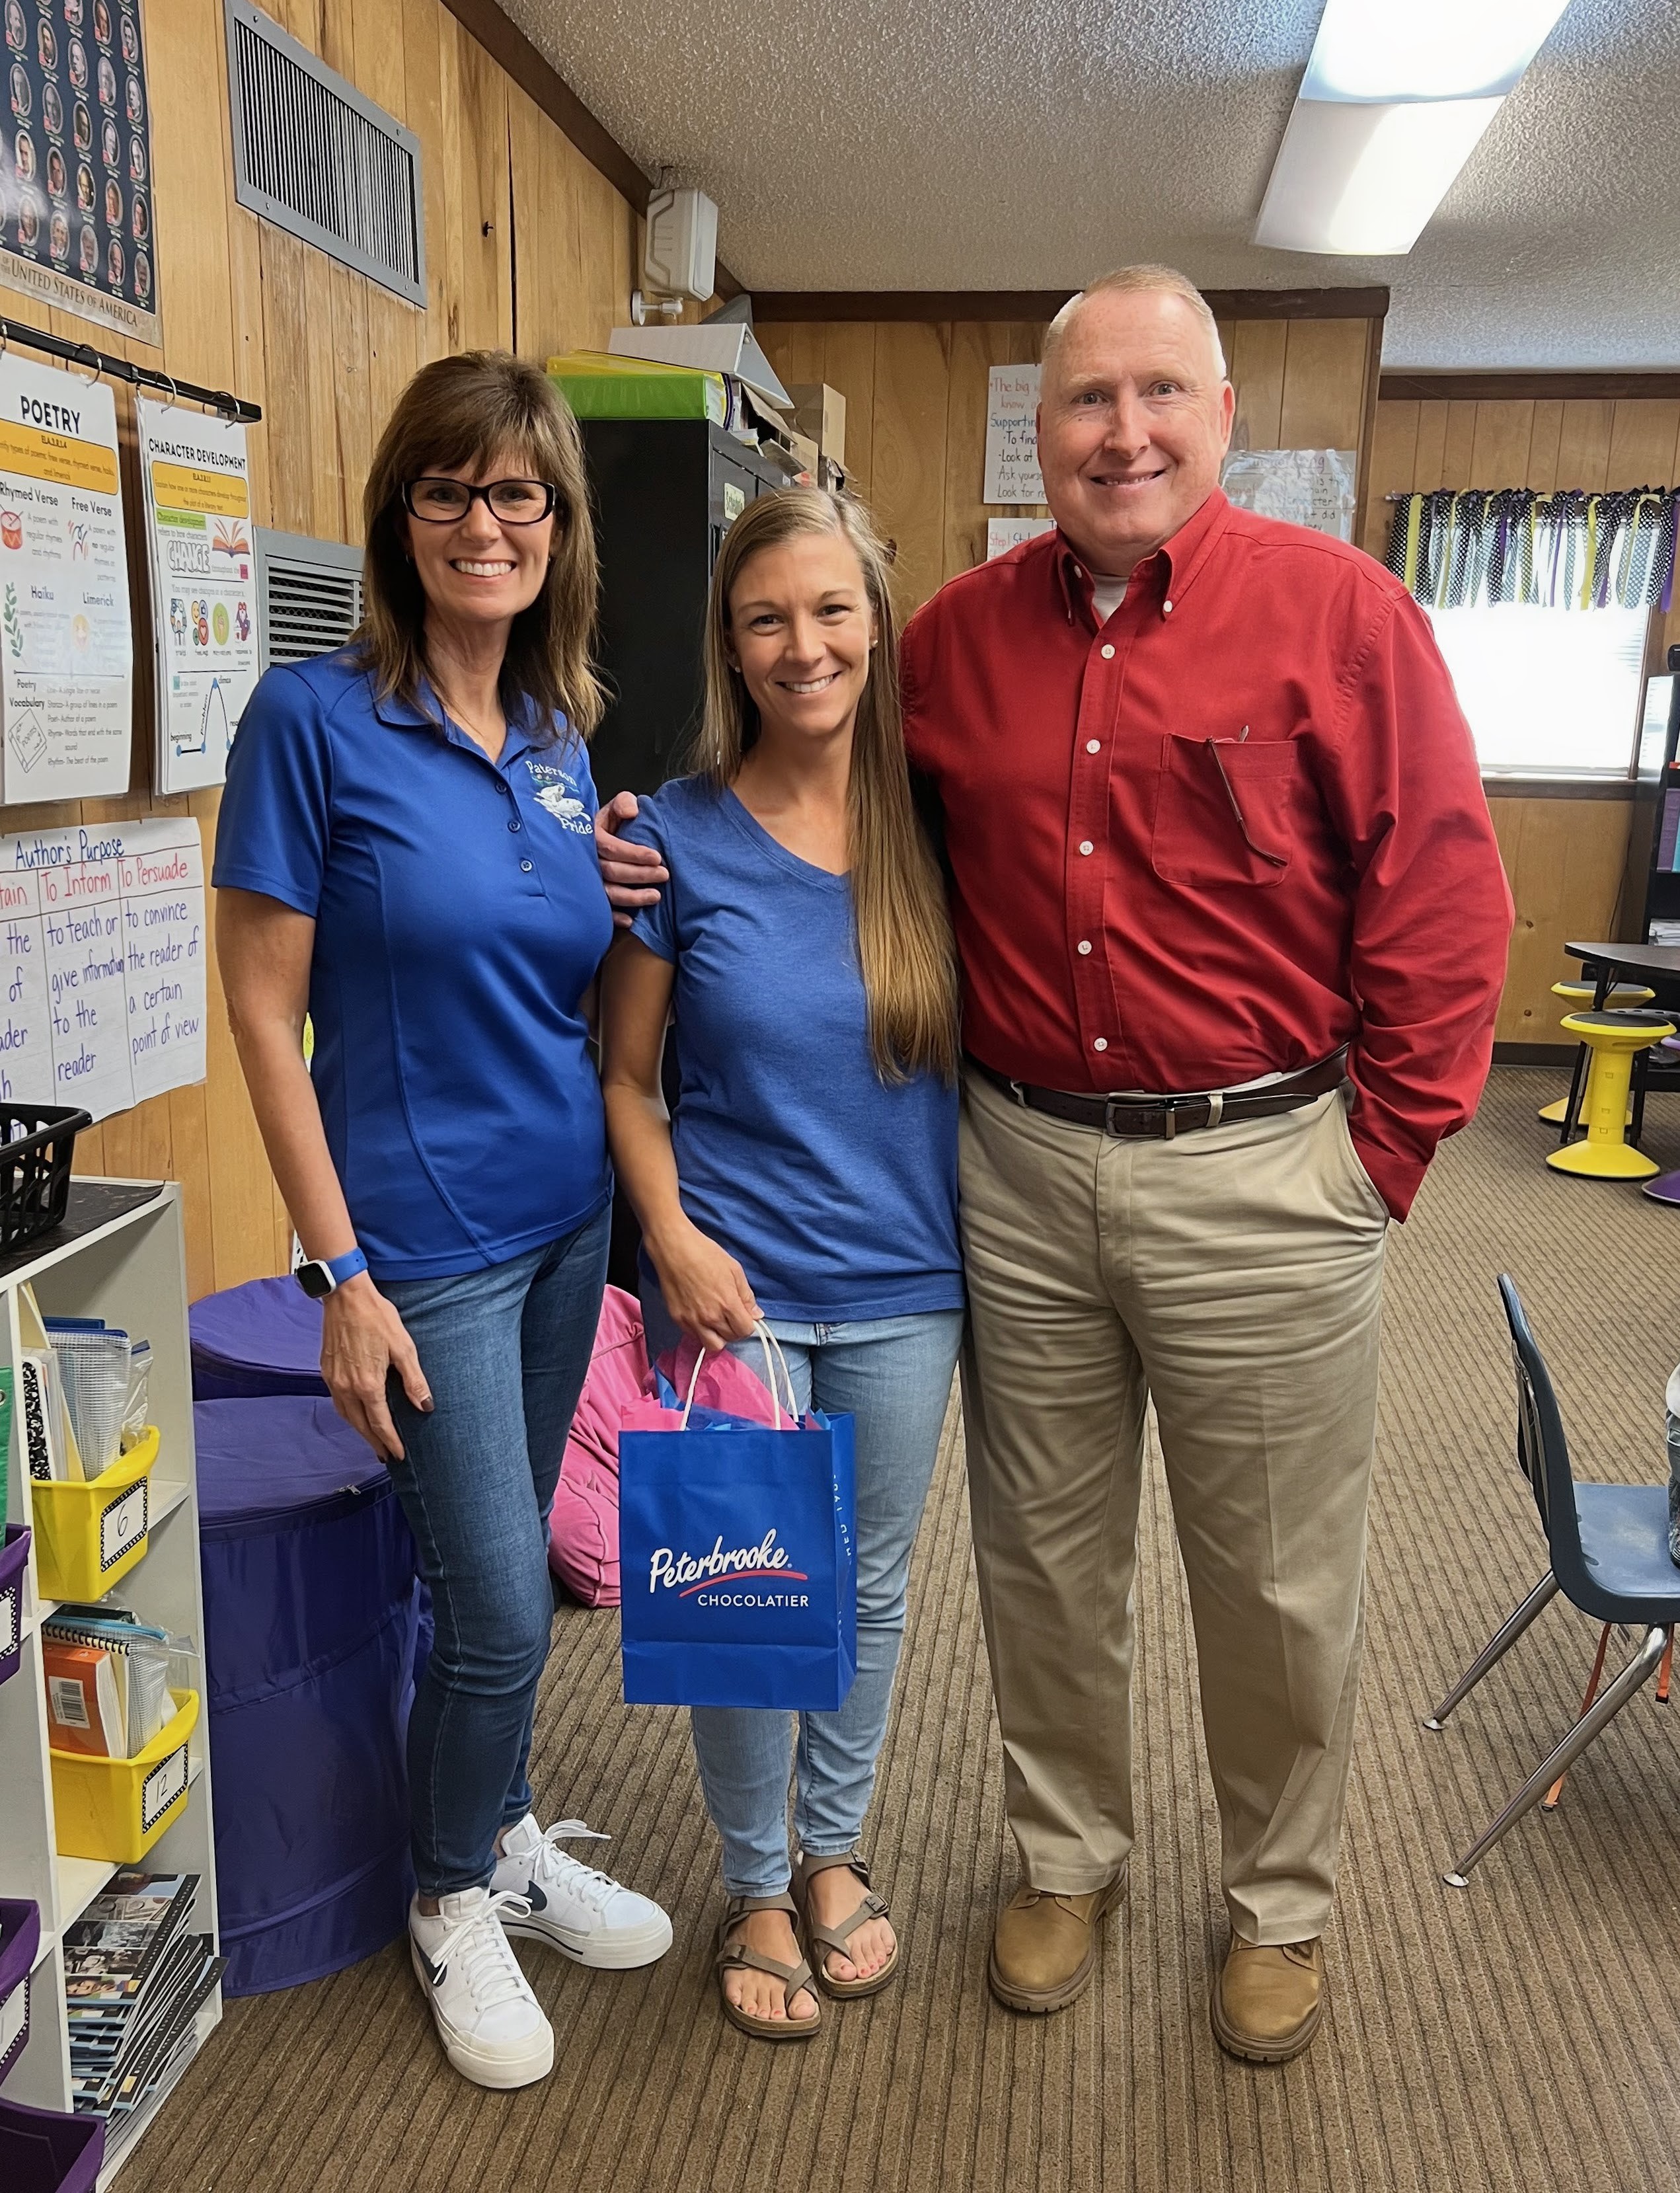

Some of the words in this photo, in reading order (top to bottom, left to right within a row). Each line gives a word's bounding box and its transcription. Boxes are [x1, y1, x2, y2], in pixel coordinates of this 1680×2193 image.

[12, 258, 51, 289] UNITED
[54, 278, 85, 305] STATES
[87, 295, 96, 307] OF
[100, 299, 137, 327] AMERICA
[994, 377, 1012, 392] The
[1015, 378, 1029, 397] big
[20, 395, 80, 434] POETRY
[1006, 431, 1016, 445] To
[149, 438, 195, 461] CHARACTER
[197, 449, 245, 471] DEVELOPMENT
[1002, 447, 1020, 462] Look
[1024, 449, 1032, 462] at
[997, 465, 1016, 481] Ask
[34, 489, 58, 506] Verse
[997, 484, 1016, 498] Look
[1021, 483, 1034, 497] for
[72, 497, 89, 512] Free
[90, 501, 112, 517] Verse
[168, 540, 210, 574] CHANGE
[31, 585, 54, 600] Haiku
[83, 592, 114, 607] Limerick
[17, 679, 36, 692] Poetry
[9, 697, 45, 711] Vocabulary
[525, 761, 577, 787] Paterson
[559, 818, 593, 834] Pride
[16, 835, 71, 870] Author's
[79, 829, 124, 865] Purpose
[41, 872, 57, 902] To
[63, 861, 111, 897] Inform
[118, 859, 132, 888] To
[136, 852, 188, 886] Persuade
[47, 915, 63, 947] to
[66, 907, 102, 943] teach
[107, 915, 118, 936] or
[126, 899, 138, 928] to
[144, 902, 188, 927] convince
[7, 923, 32, 954] the
[128, 941, 145, 972] the
[150, 933, 183, 967] reader
[188, 925, 199, 956] of
[9, 966, 22, 1002] of
[52, 968, 79, 1004] give
[83, 946, 124, 984] information
[130, 995, 136, 1014] a
[144, 978, 182, 1010] certain
[54, 1006, 70, 1035] to
[76, 999, 97, 1028] the
[132, 1016, 157, 1065] point
[161, 1012, 170, 1045] of
[175, 1017, 199, 1039] view
[58, 1042, 96, 1081] reader
[118, 1504, 128, 1537] 6
[698, 1594, 809, 1607] CHOCOLATIER
[156, 1774, 167, 1803] 12
